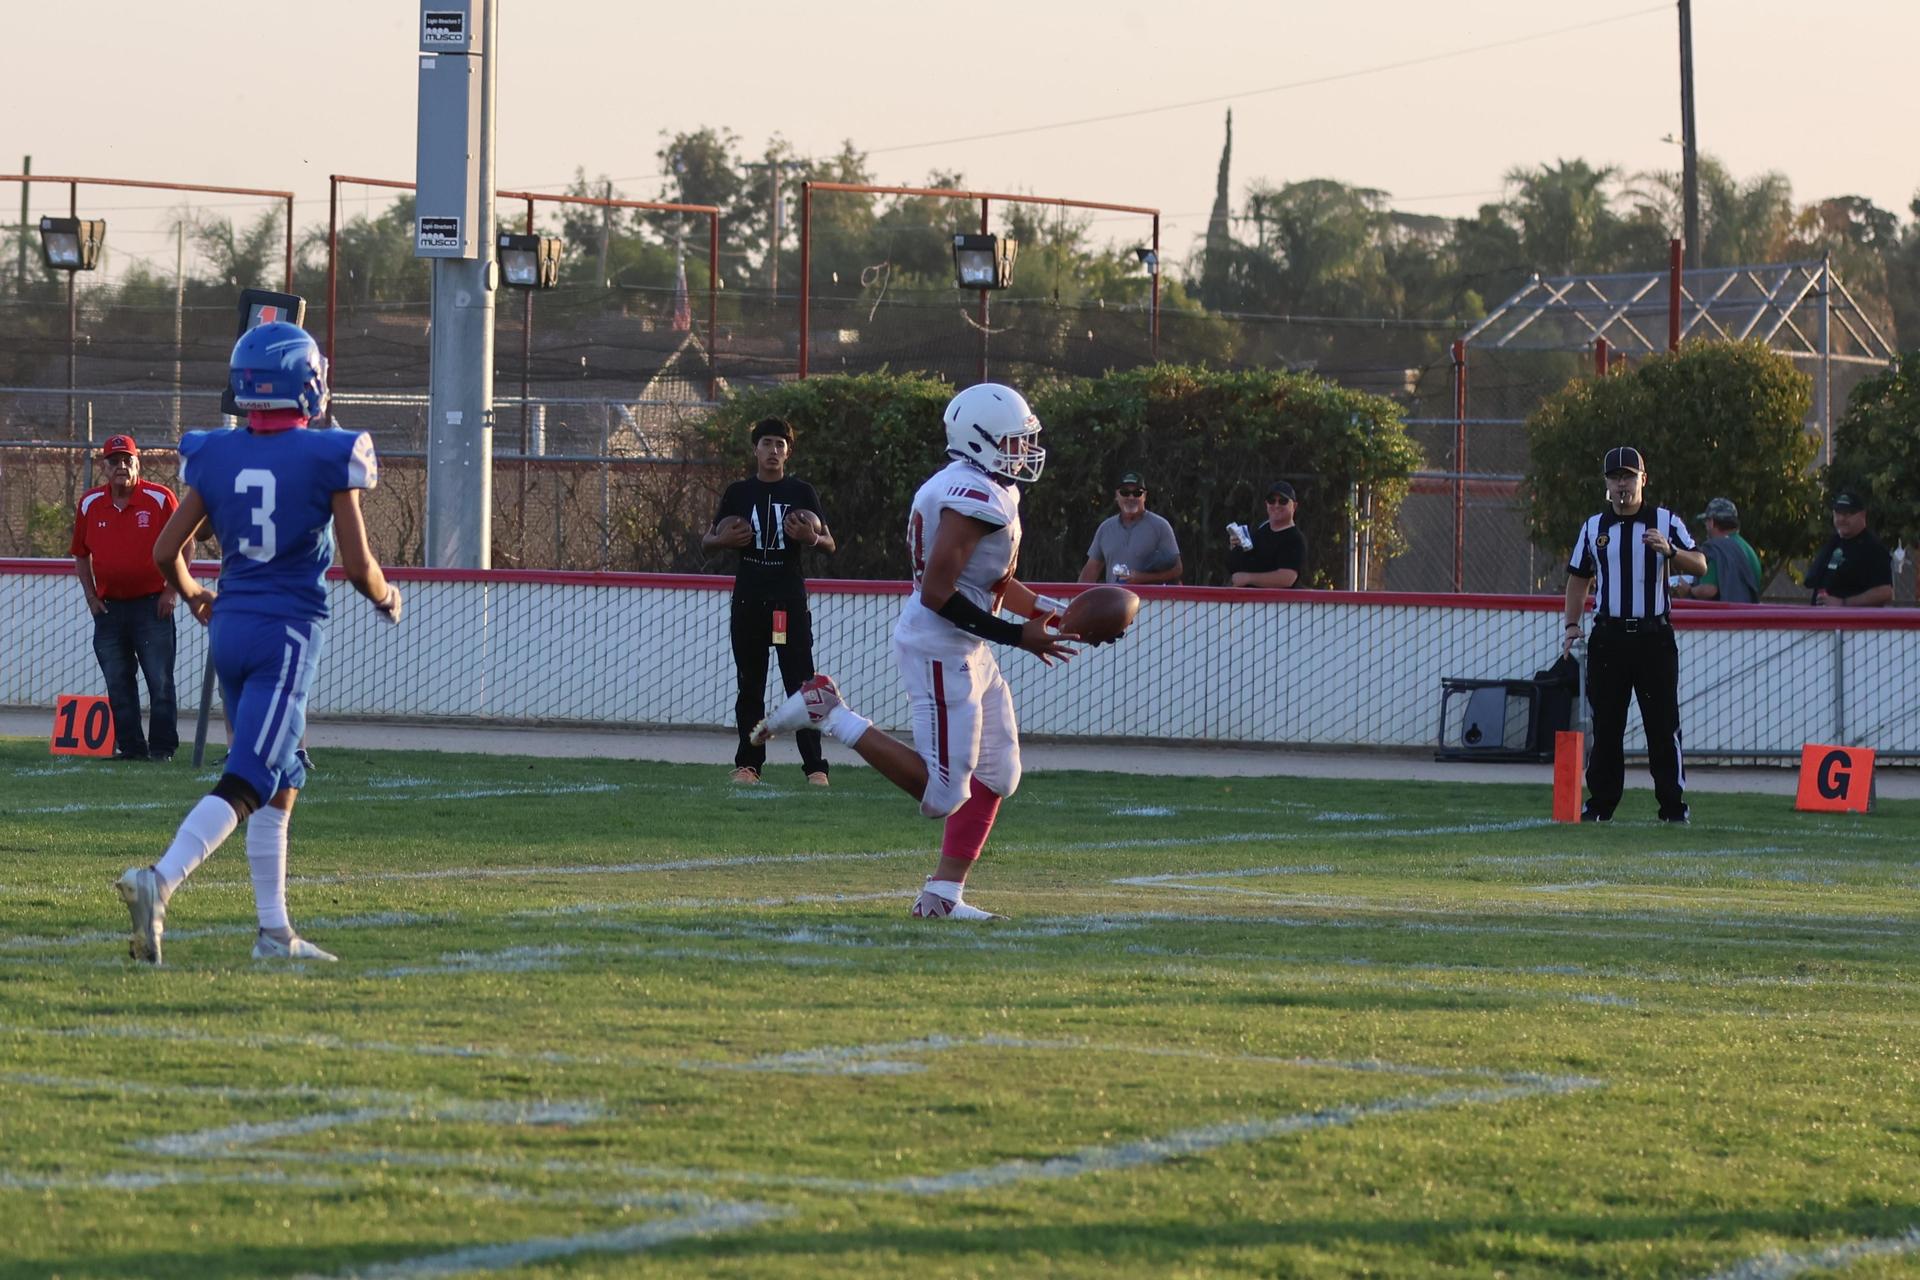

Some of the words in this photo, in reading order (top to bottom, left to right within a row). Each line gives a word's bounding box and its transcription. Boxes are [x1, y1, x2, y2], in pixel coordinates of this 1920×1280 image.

[234, 468, 277, 563] 3
[55, 699, 110, 750] 10
[1817, 749, 1853, 801] G
